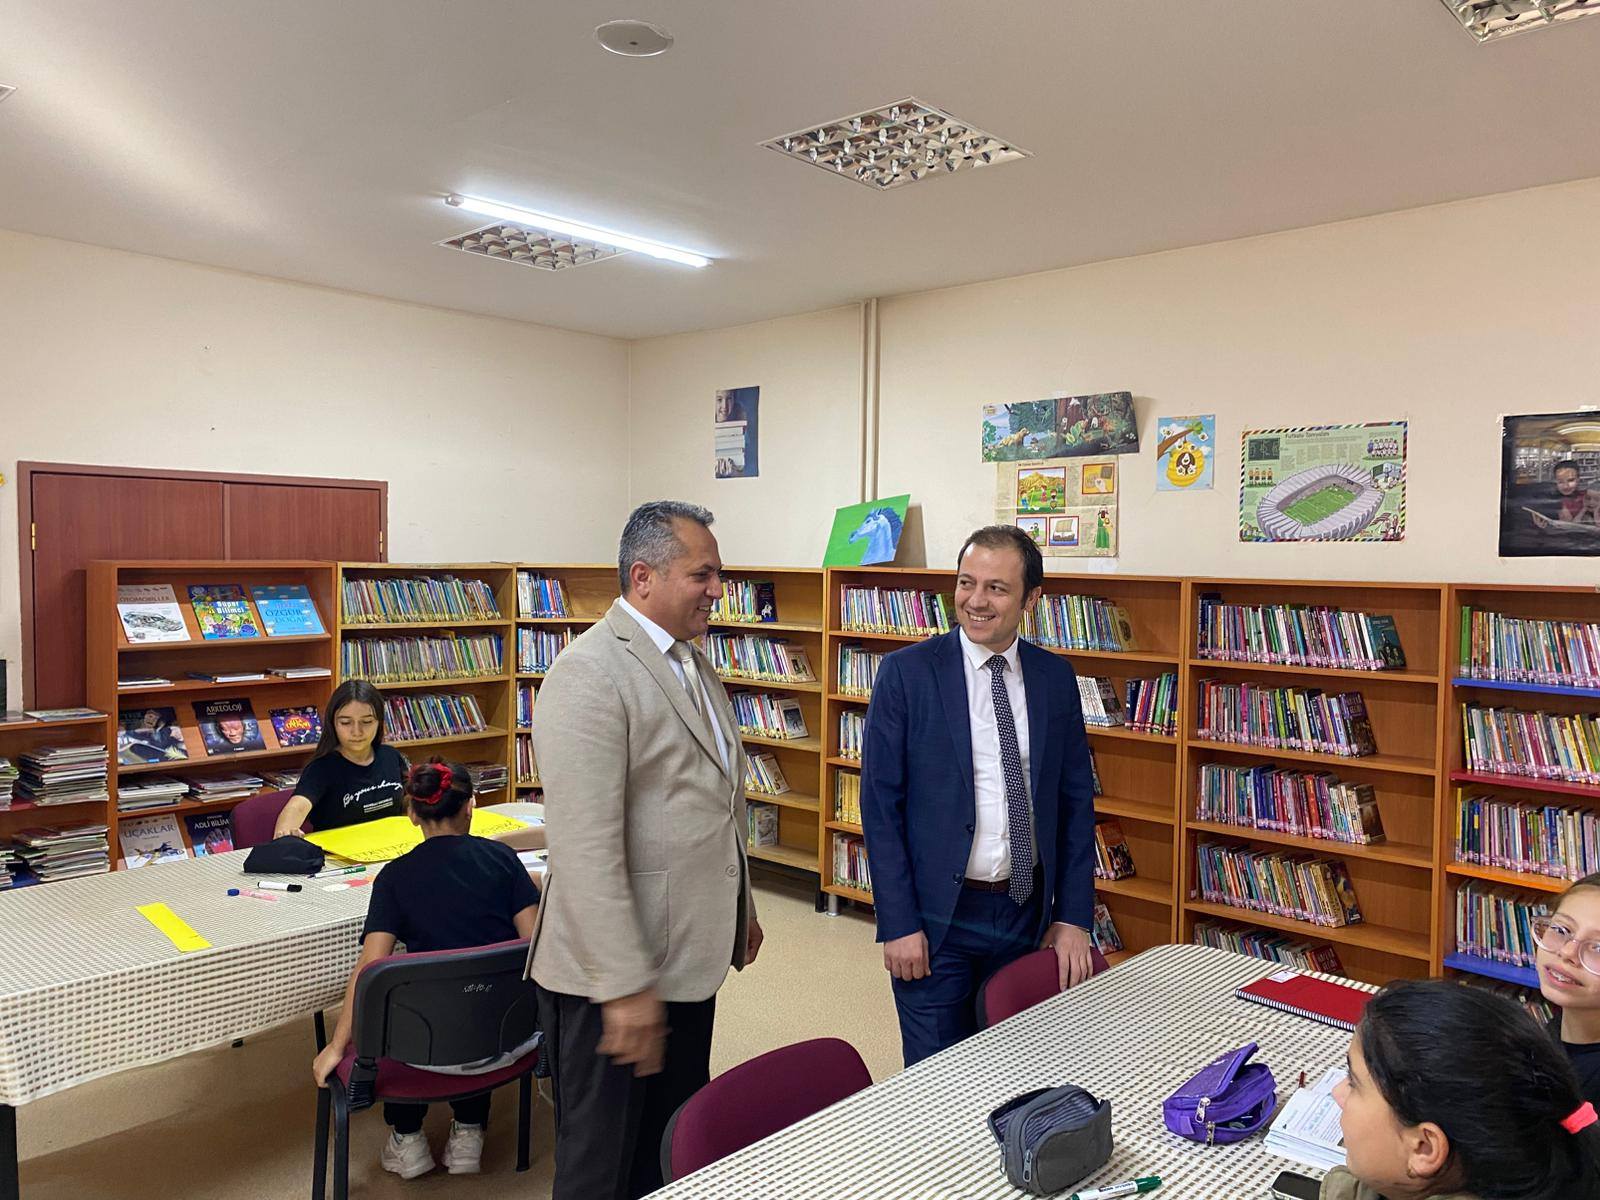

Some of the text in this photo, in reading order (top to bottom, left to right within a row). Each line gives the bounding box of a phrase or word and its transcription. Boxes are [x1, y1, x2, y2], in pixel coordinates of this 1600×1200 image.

[216, 600, 239, 608] Süper
[216, 606, 245, 614] Bilimci
[194, 820, 210, 829] ADLİ
[124, 824, 175, 838] UÇAKLAR
